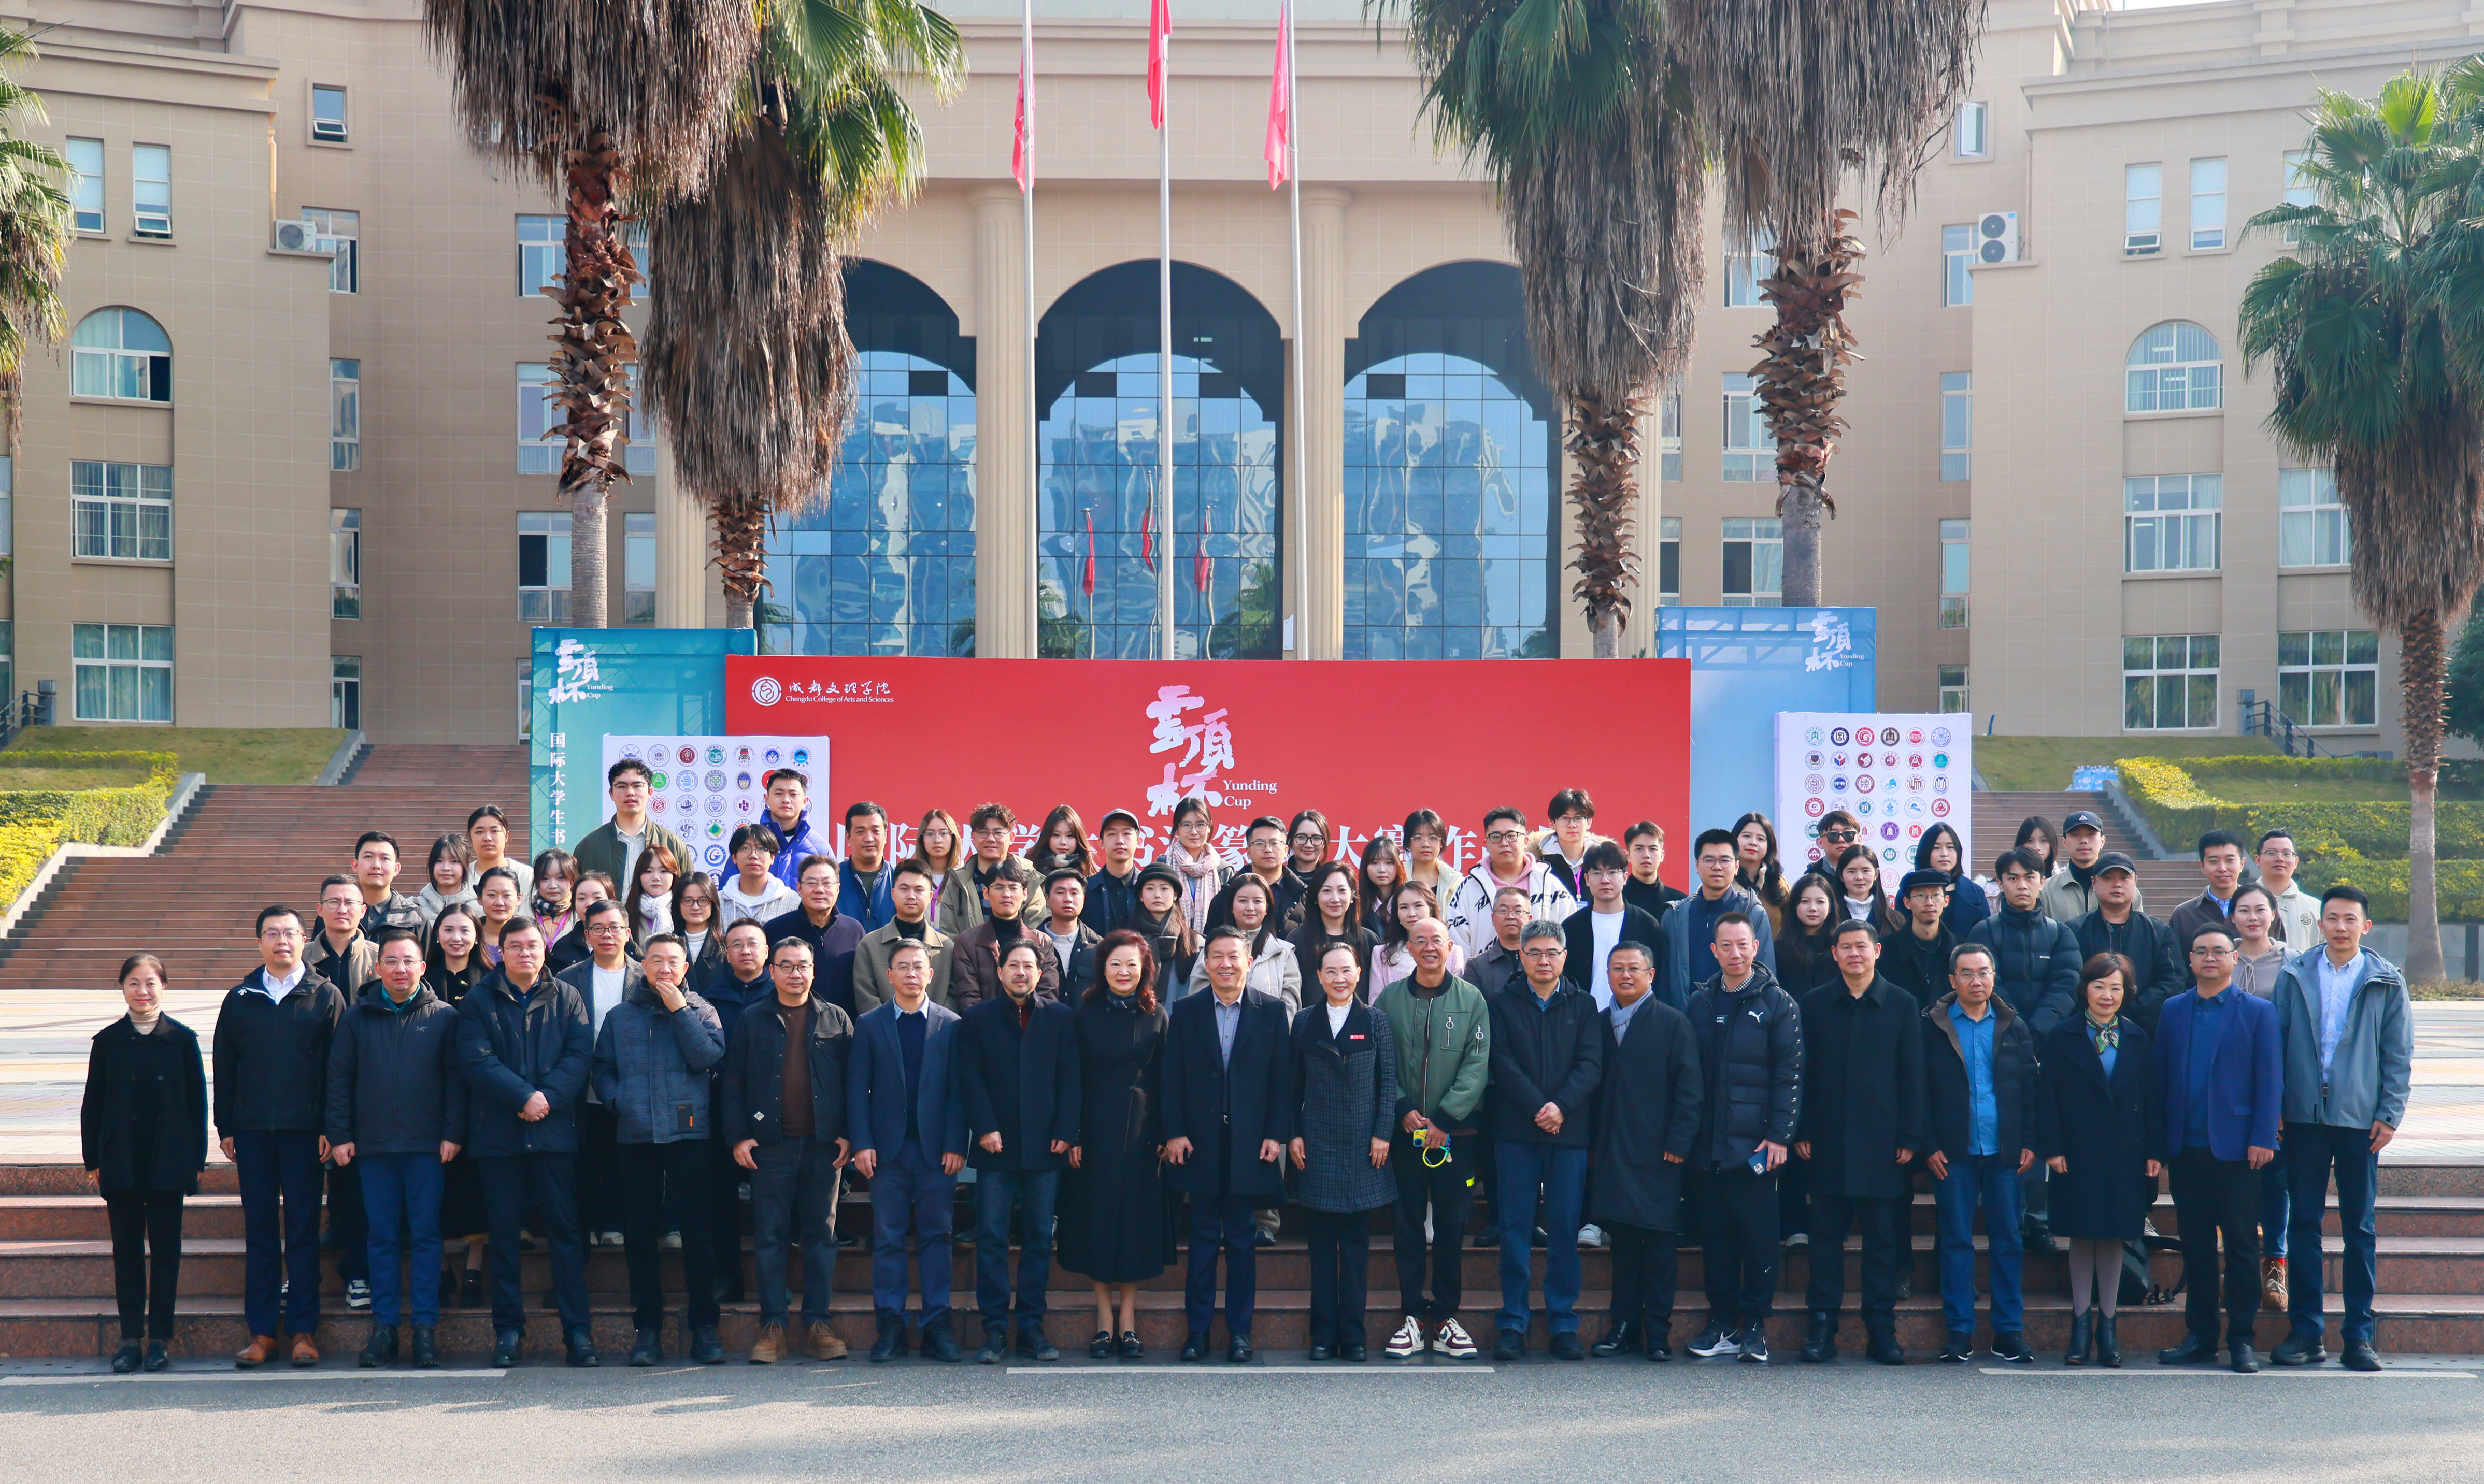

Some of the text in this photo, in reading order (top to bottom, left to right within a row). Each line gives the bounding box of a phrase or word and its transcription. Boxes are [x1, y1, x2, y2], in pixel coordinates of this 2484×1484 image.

[789, 680, 891, 696] 成都文理学院
[550, 732, 566, 845] 国际大学生书
[1223, 780, 1277, 794] Yunding
[1224, 796, 1252, 809] Cup
